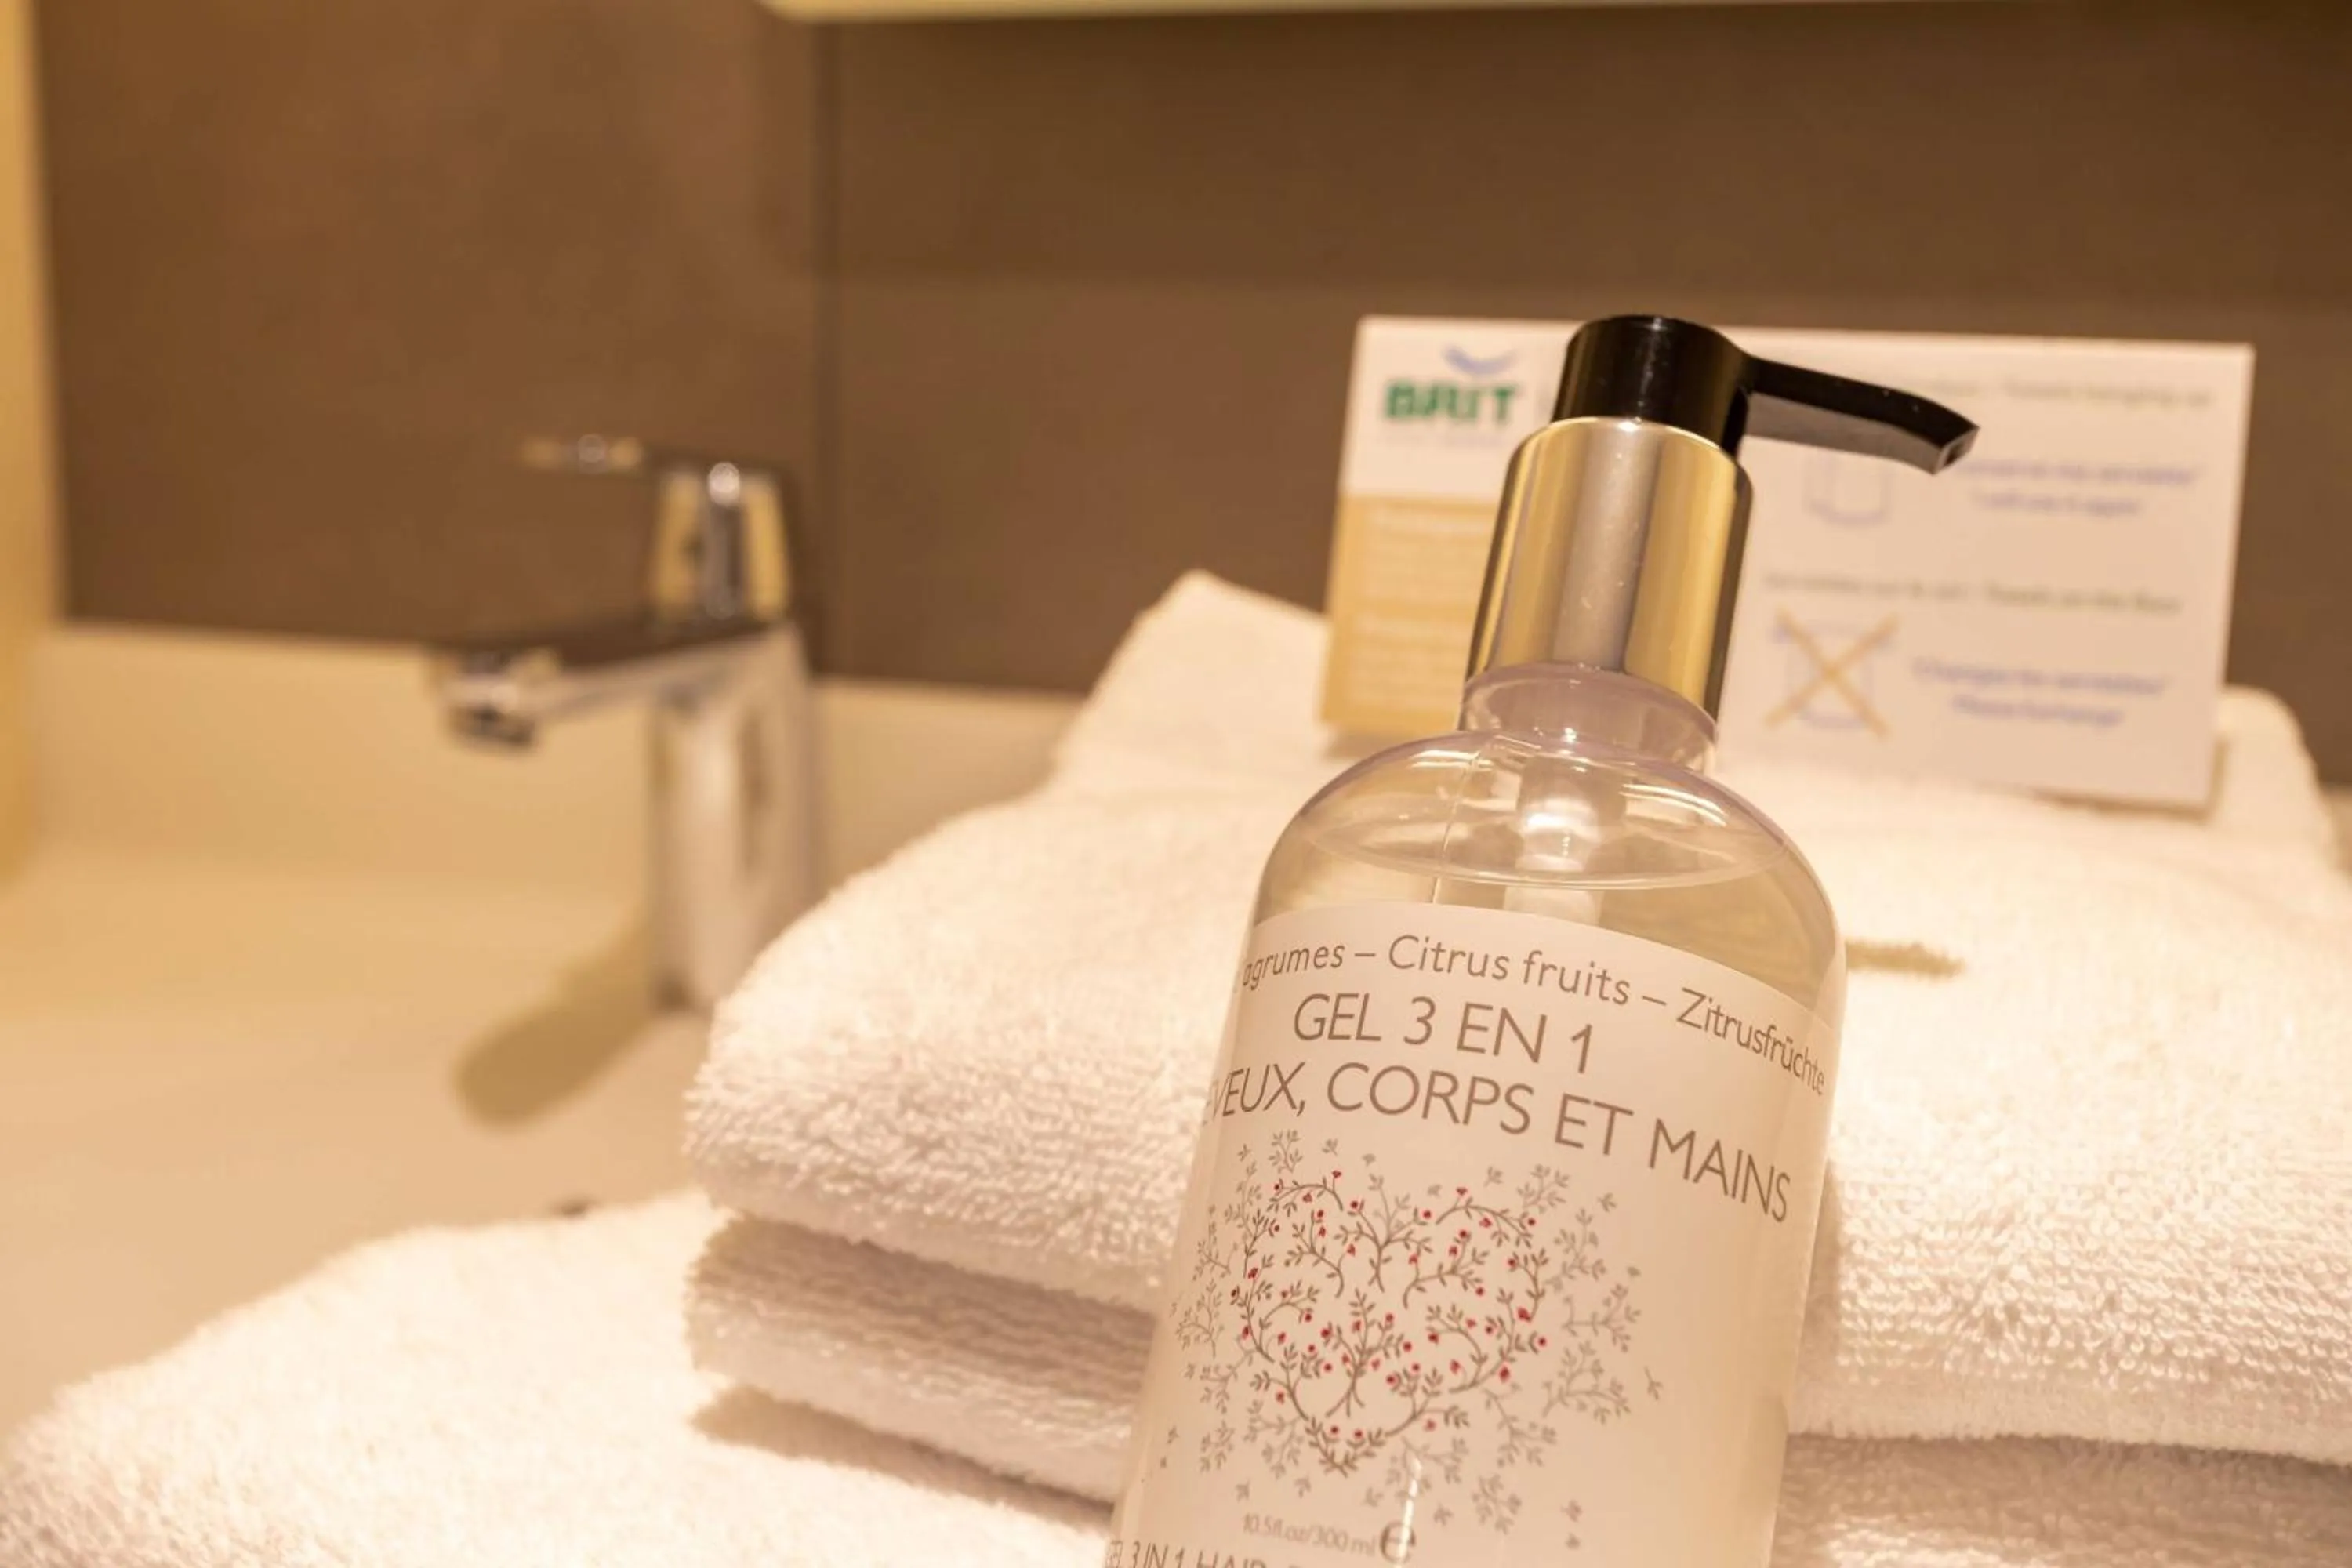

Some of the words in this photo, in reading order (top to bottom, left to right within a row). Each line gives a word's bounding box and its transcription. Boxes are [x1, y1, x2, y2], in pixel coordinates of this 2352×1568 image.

[1243, 944, 1346, 991] agrumes
[1388, 934, 1510, 981] Citrus
[1522, 949, 1632, 1007] fruits
[1676, 987, 1825, 1096] Zitrusfrüchte
[1294, 992, 1382, 1042] GEL
[1403, 996, 1437, 1046] 3
[1456, 1001, 1548, 1064] EN
[1570, 1023, 1593, 1074] 1
[1202, 1061, 1306, 1127] VEUX,
[1327, 1061, 1535, 1135] CORPS
[1554, 1093, 1635, 1156] ET
[1647, 1117, 1791, 1224] MAINS
